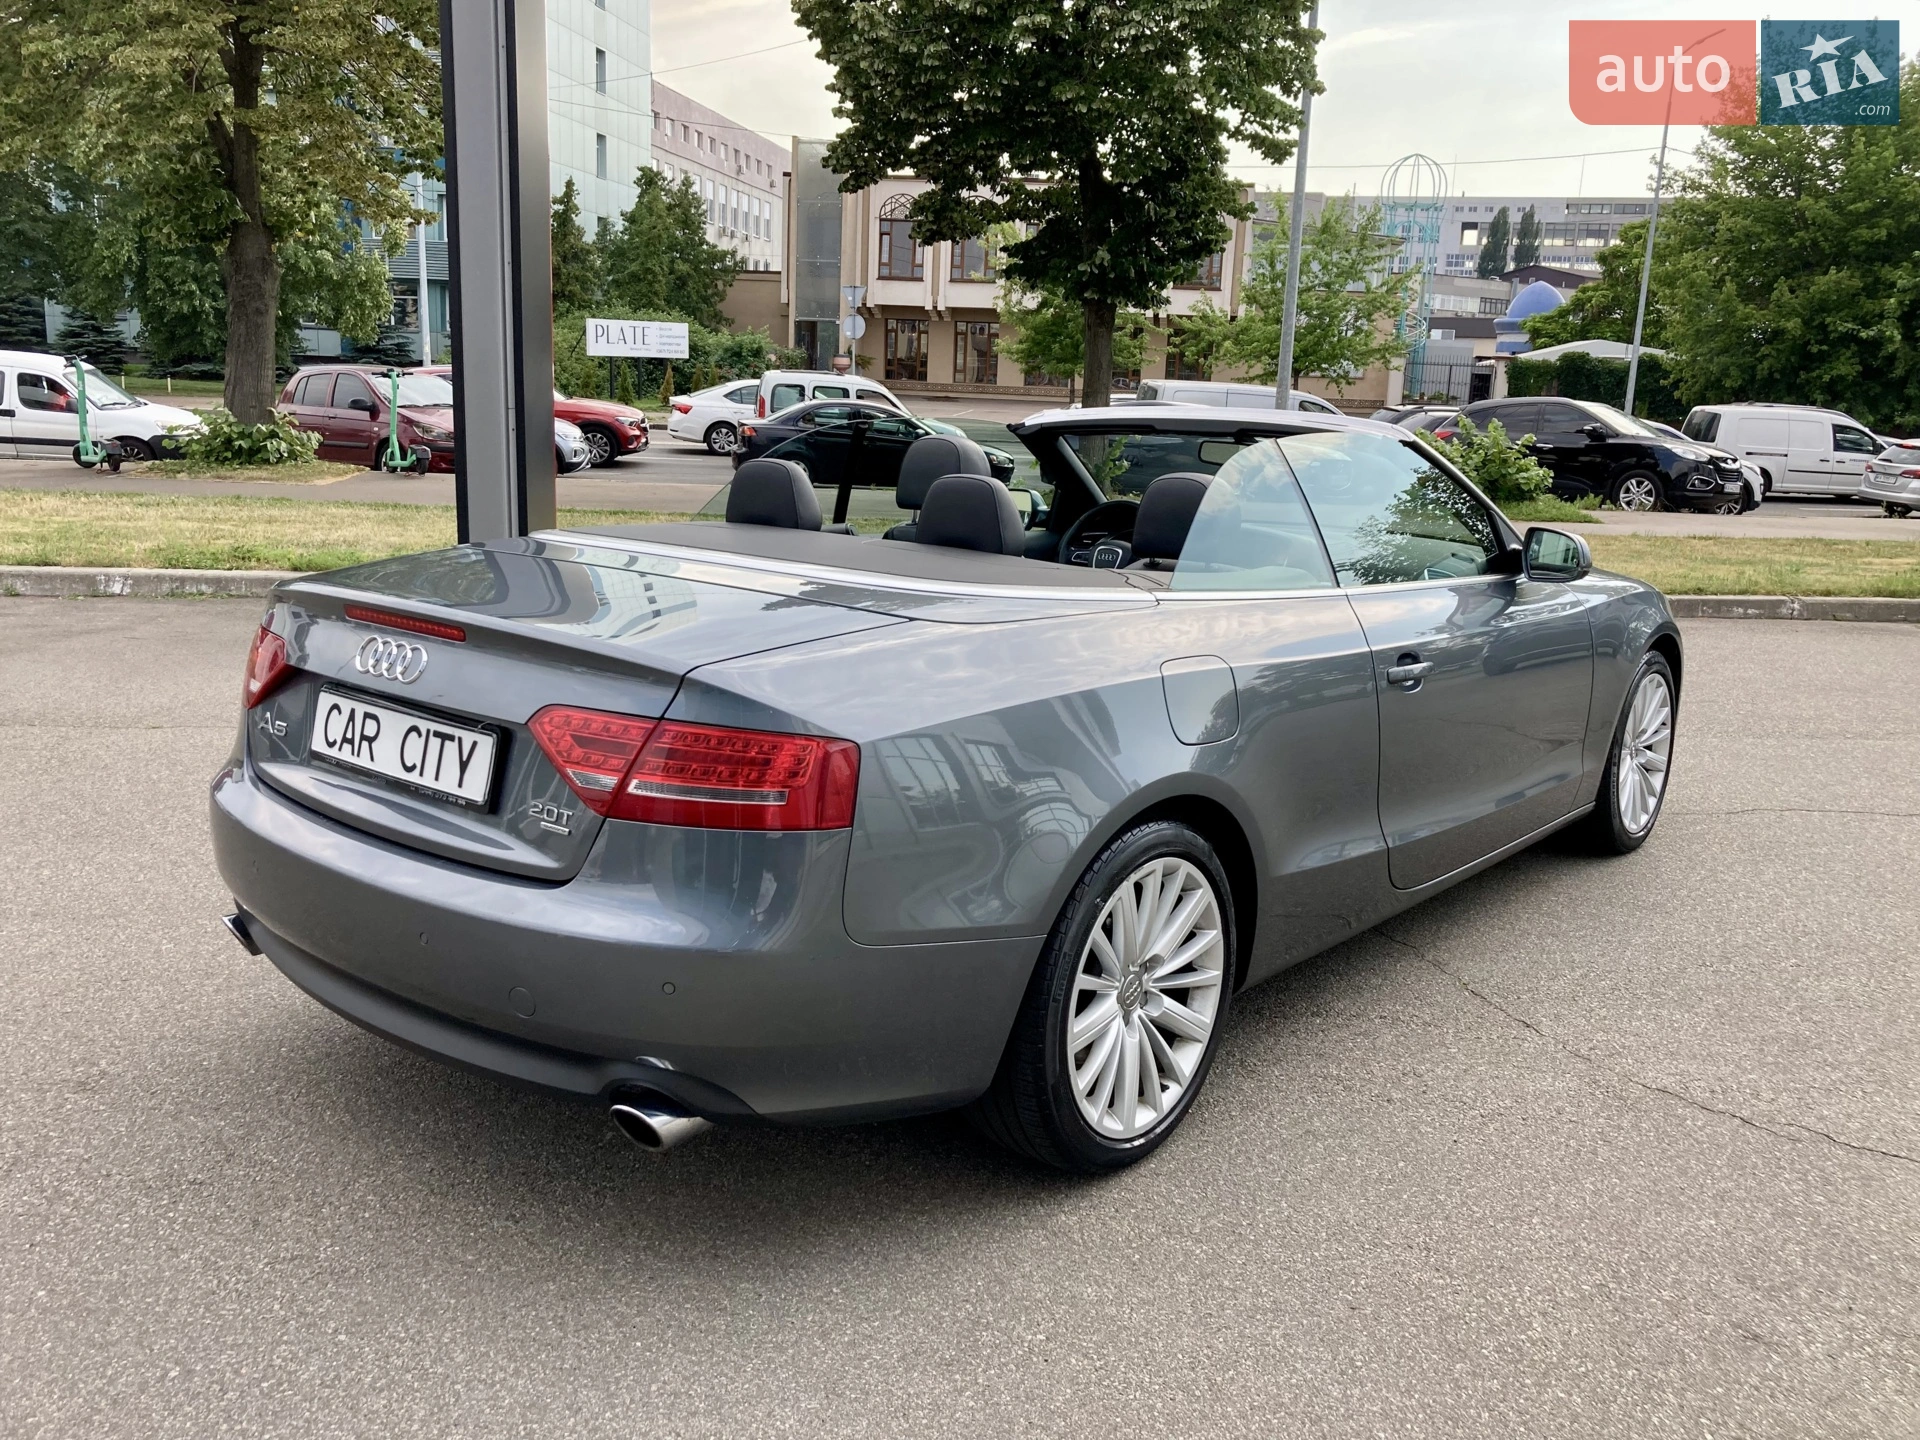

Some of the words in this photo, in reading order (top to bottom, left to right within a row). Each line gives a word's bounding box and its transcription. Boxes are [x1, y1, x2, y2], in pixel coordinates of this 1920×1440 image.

[595, 324, 651, 346] PLATE
[258, 712, 288, 736] A5
[324, 703, 381, 762] CAR
[400, 724, 479, 789] CITY
